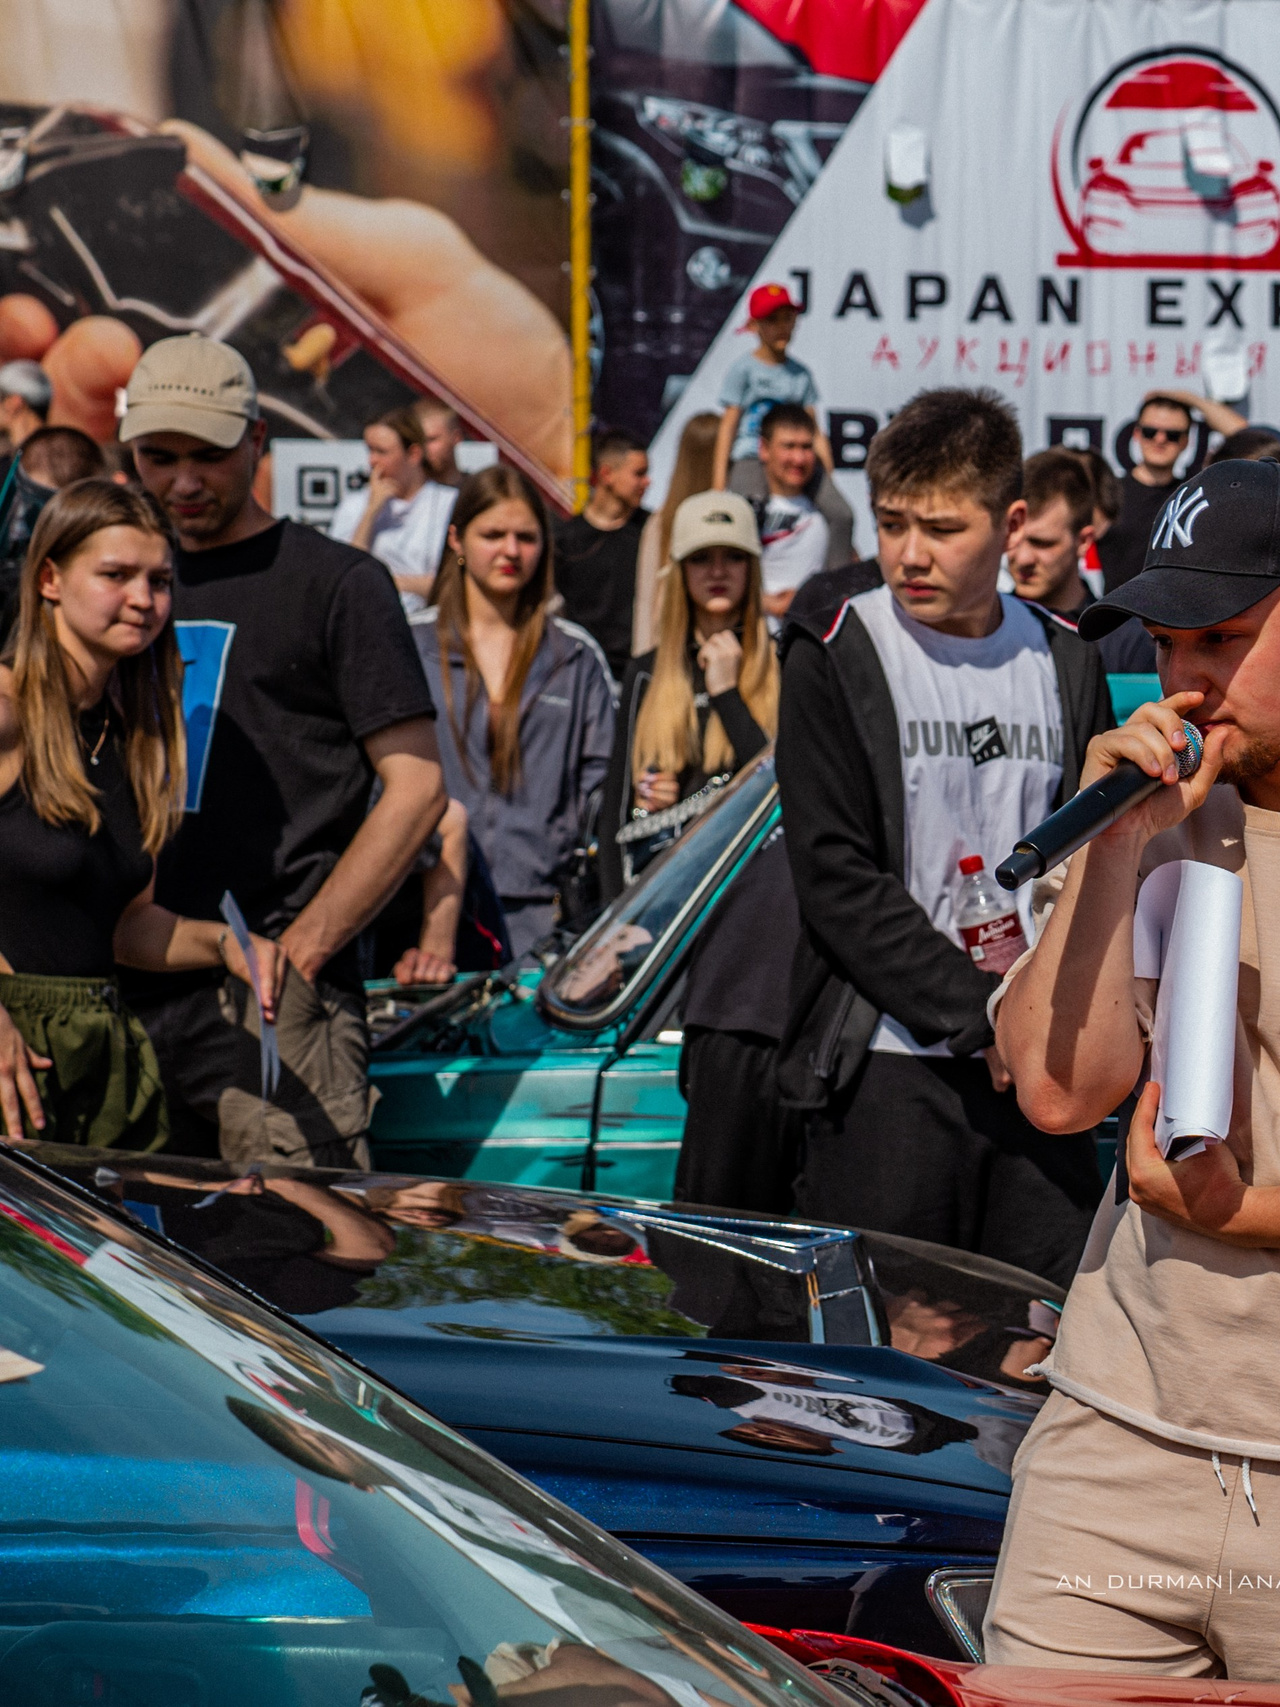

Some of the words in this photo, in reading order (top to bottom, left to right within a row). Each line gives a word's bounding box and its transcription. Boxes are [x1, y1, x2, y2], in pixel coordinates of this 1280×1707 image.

[789, 267, 1081, 324] JAPAN
[871, 335, 1202, 388] АУКЦИОНЫ
[1151, 485, 1210, 550] NY
